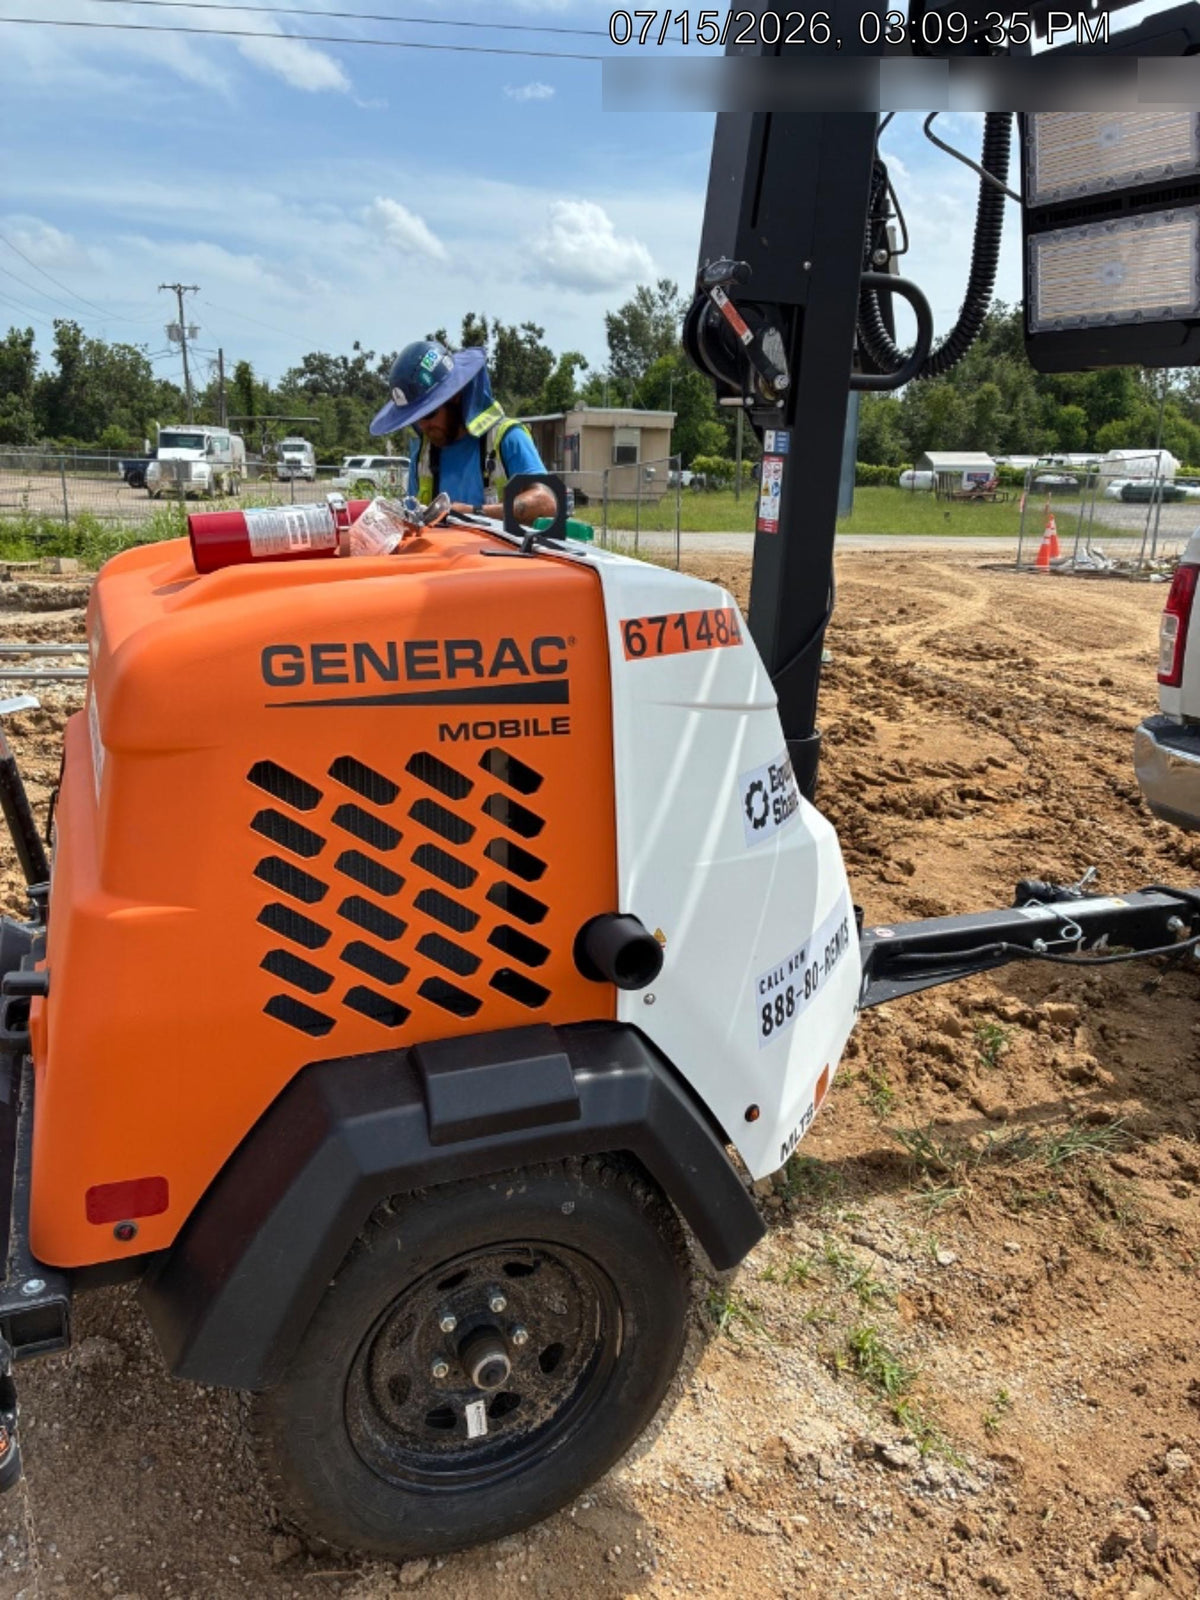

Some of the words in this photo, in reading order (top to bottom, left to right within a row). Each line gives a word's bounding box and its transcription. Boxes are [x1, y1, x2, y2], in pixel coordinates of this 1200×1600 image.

[624, 609, 741, 657] 671484
[438, 716, 570, 742] MOBILE
[759, 967, 785, 995] CALL
[788, 948, 806, 975] NOW
